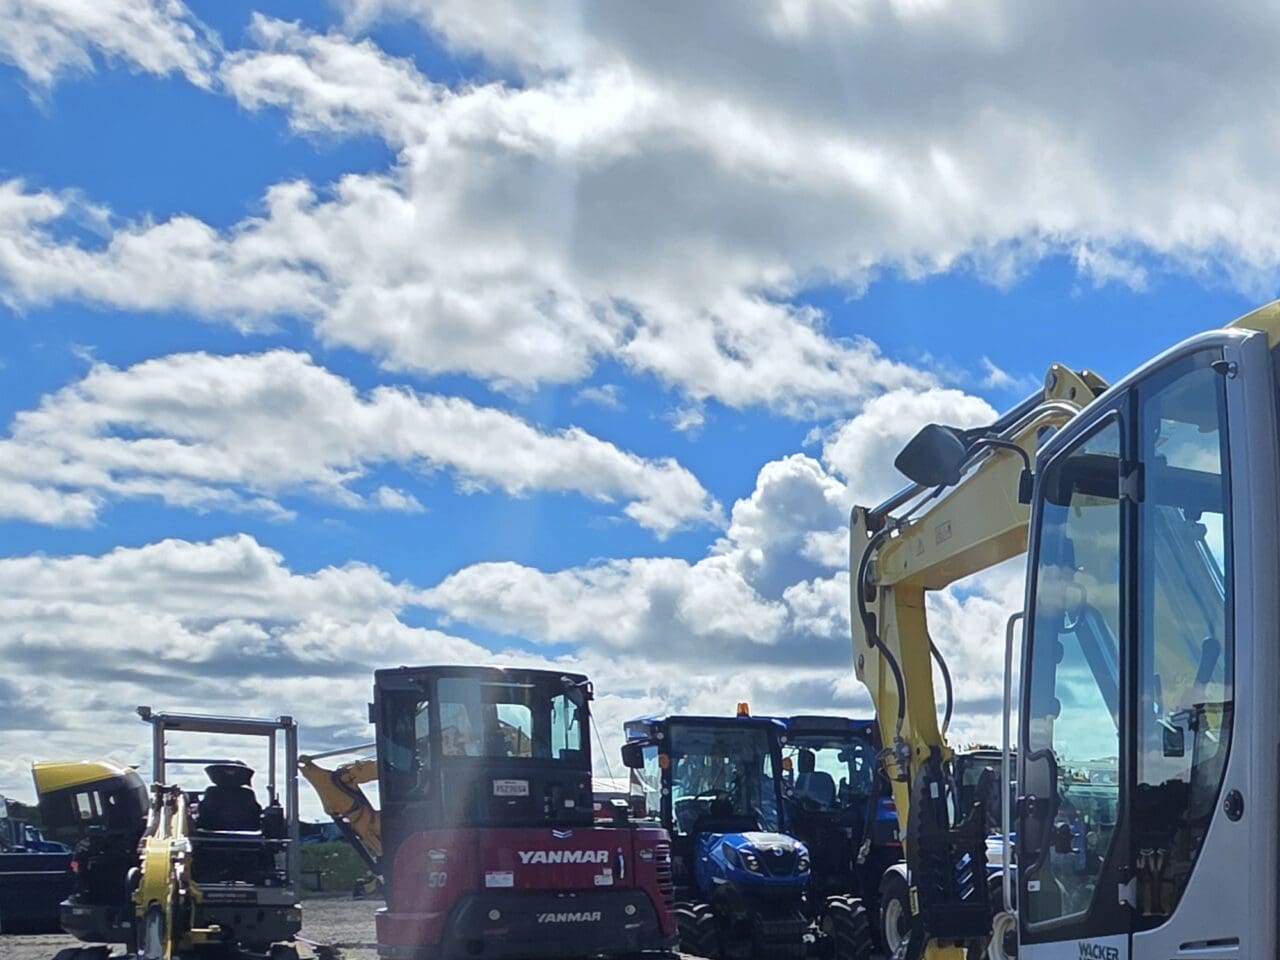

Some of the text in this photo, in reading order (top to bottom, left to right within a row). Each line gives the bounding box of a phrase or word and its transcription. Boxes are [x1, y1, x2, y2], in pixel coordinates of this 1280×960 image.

[518, 850, 609, 864] YANMAR
[428, 871, 448, 888] 50
[536, 911, 602, 924] YANMAR
